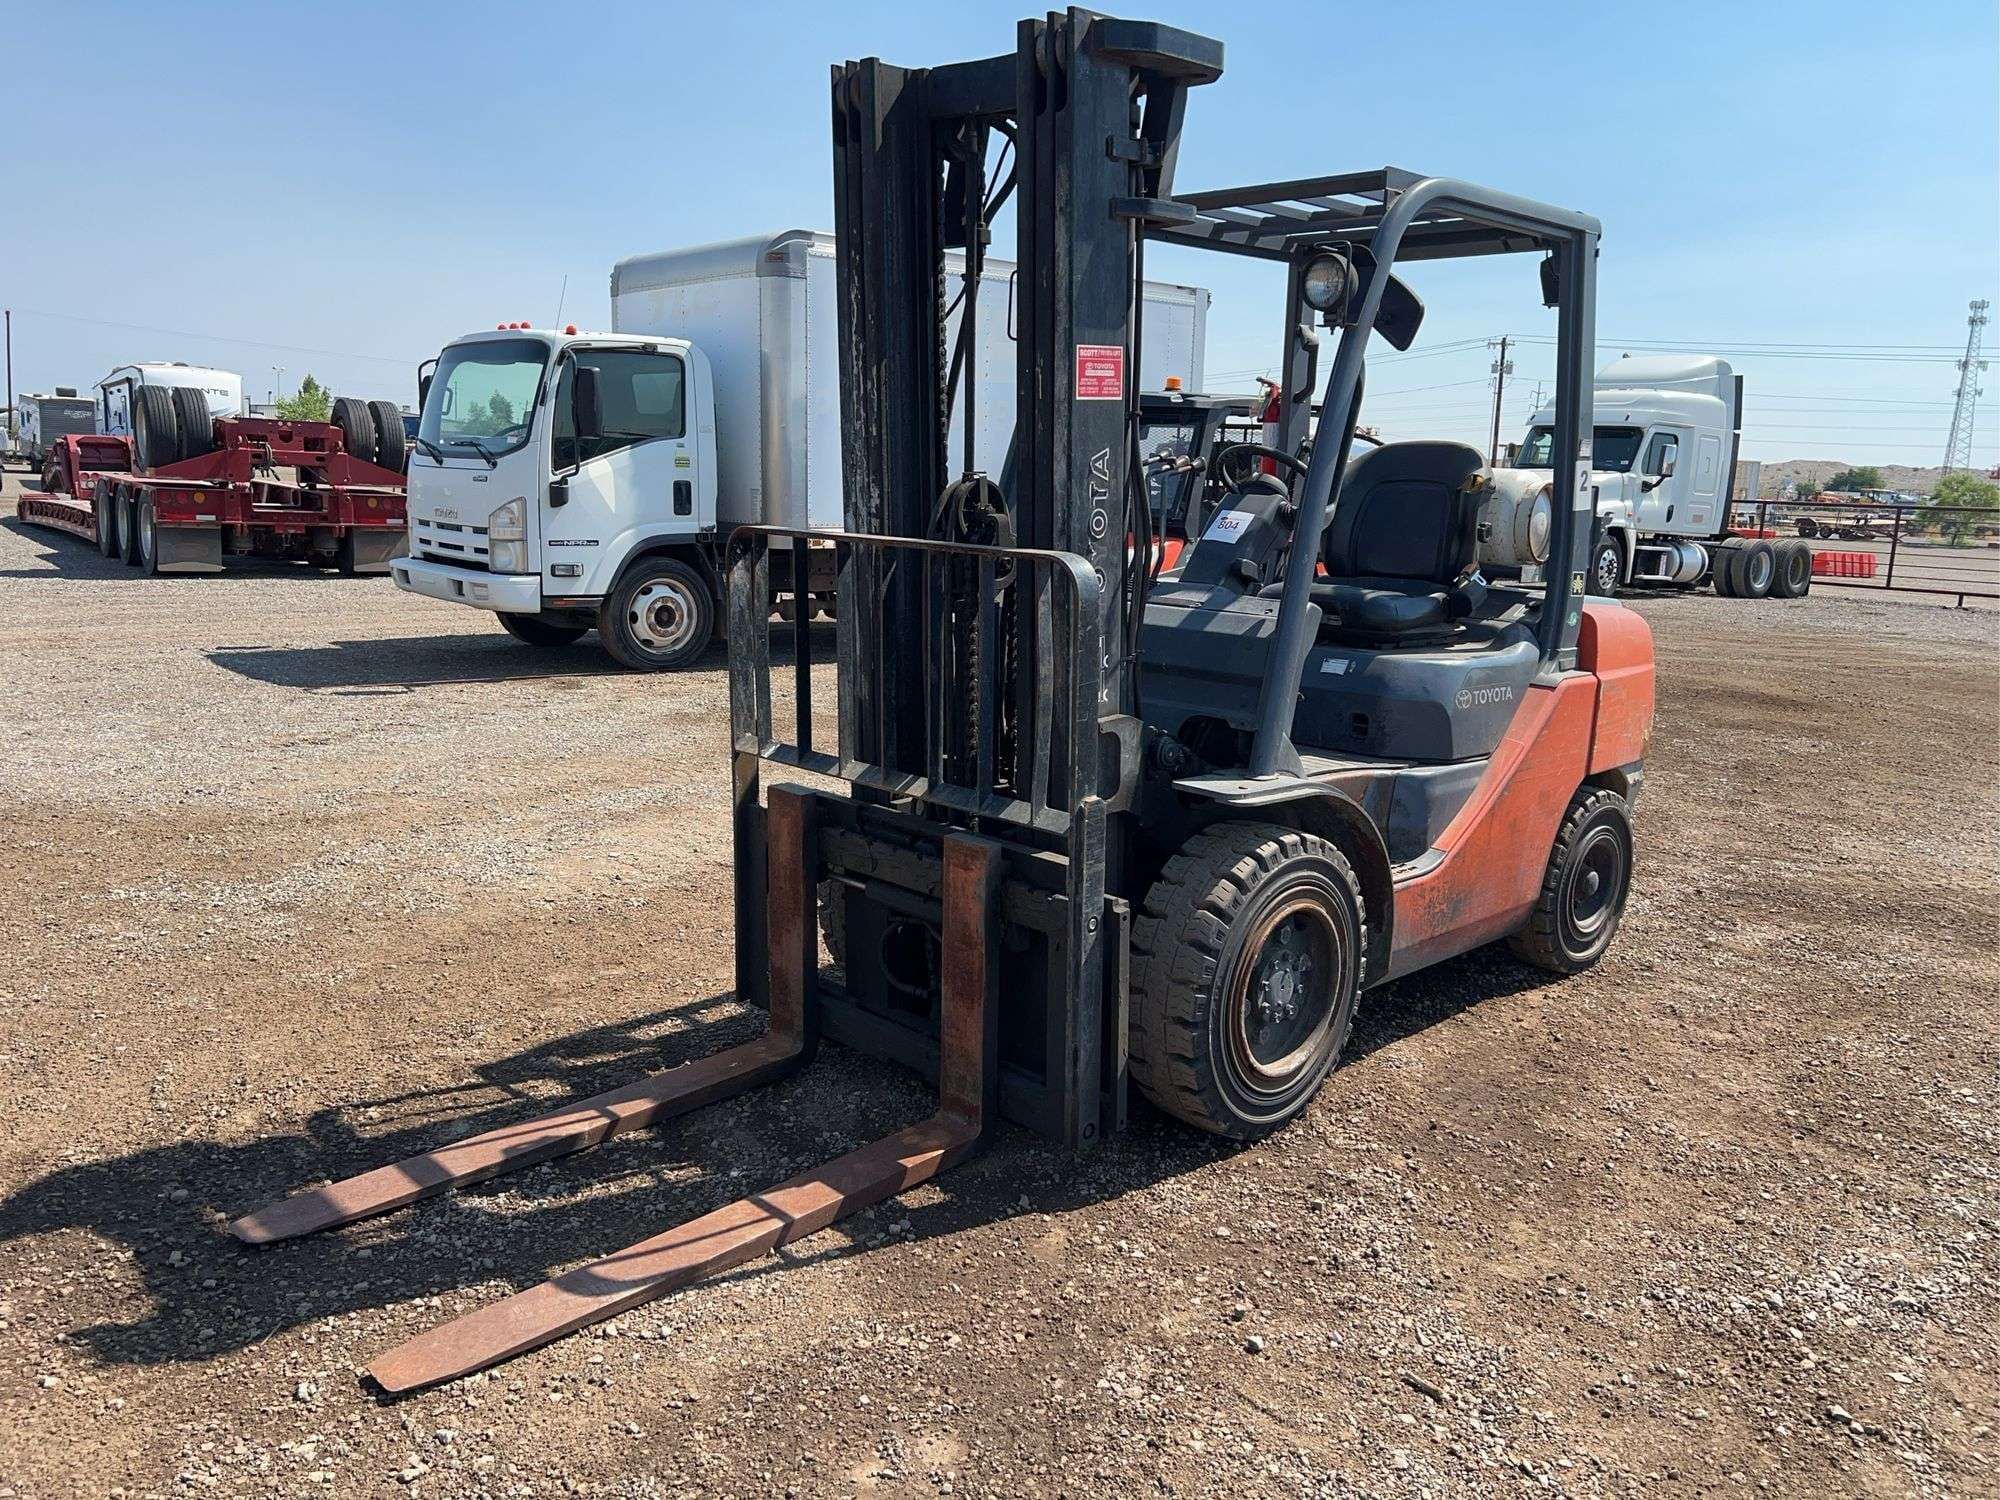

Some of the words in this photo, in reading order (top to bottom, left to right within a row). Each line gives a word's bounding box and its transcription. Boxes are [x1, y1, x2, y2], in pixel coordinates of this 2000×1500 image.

[1579, 470, 1589, 492] 2
[1217, 520, 1240, 530] 804
[1473, 687, 1513, 705] TOYOTA
